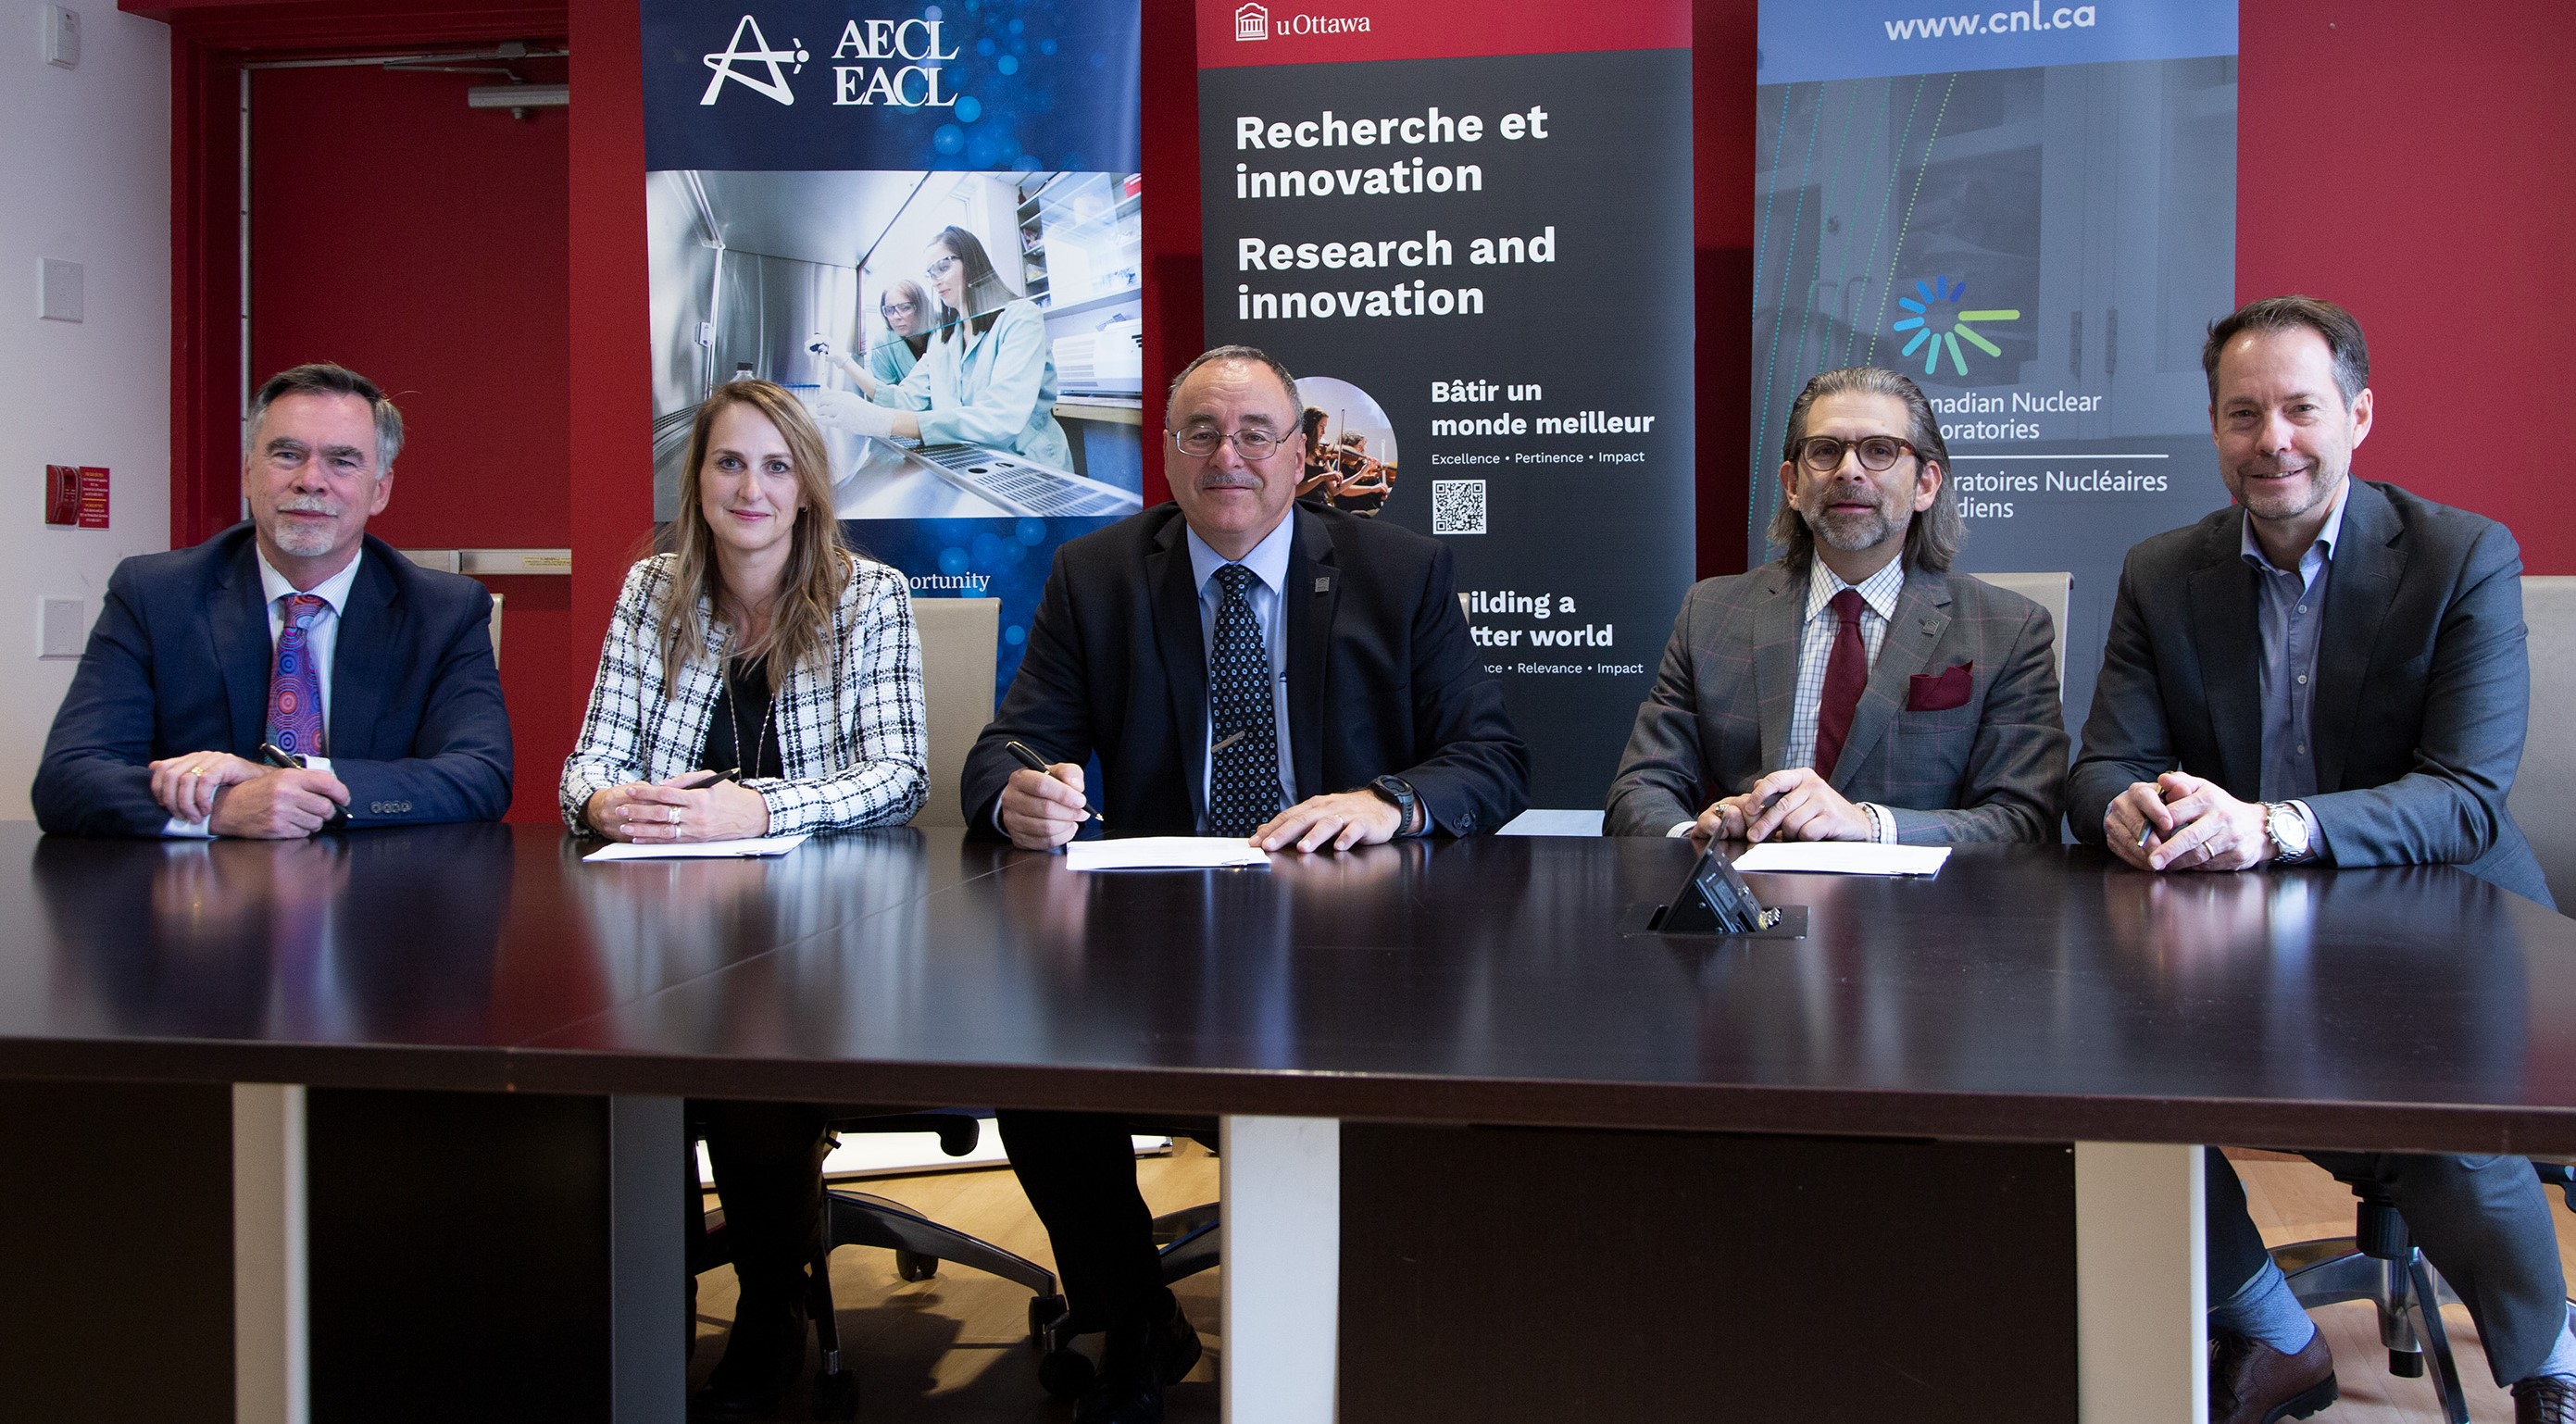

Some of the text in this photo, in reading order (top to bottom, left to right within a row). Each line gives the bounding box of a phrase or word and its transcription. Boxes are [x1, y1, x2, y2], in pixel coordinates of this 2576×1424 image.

[1276, 14, 1371, 36] uOttawa
[1884, 0, 2096, 41] www.cnl.ca
[831, 19, 960, 60] AECL
[832, 66, 958, 107] EACL
[1236, 105, 1549, 150] Recherche et
[1236, 156, 1483, 199] innovation
[1238, 226, 1557, 271] Research and
[1238, 279, 1484, 320] innovation
[1432, 379, 1543, 403] Bâtir un
[1931, 390, 2102, 414] nadian Nuclear
[1432, 410, 1656, 436] monde meilleur
[1940, 418, 2040, 440] oratories
[1432, 451, 1645, 465] Excellence Pertinence Impact
[1954, 469, 2169, 492] ratoires Nucléaires
[1957, 496, 2014, 518] diens
[910, 571, 991, 593] ortunity
[1471, 590, 1576, 619] ilding a
[1470, 624, 1613, 647] tter world
[1518, 663, 1582, 674] Relevance
[1597, 663, 1644, 677] Impact
